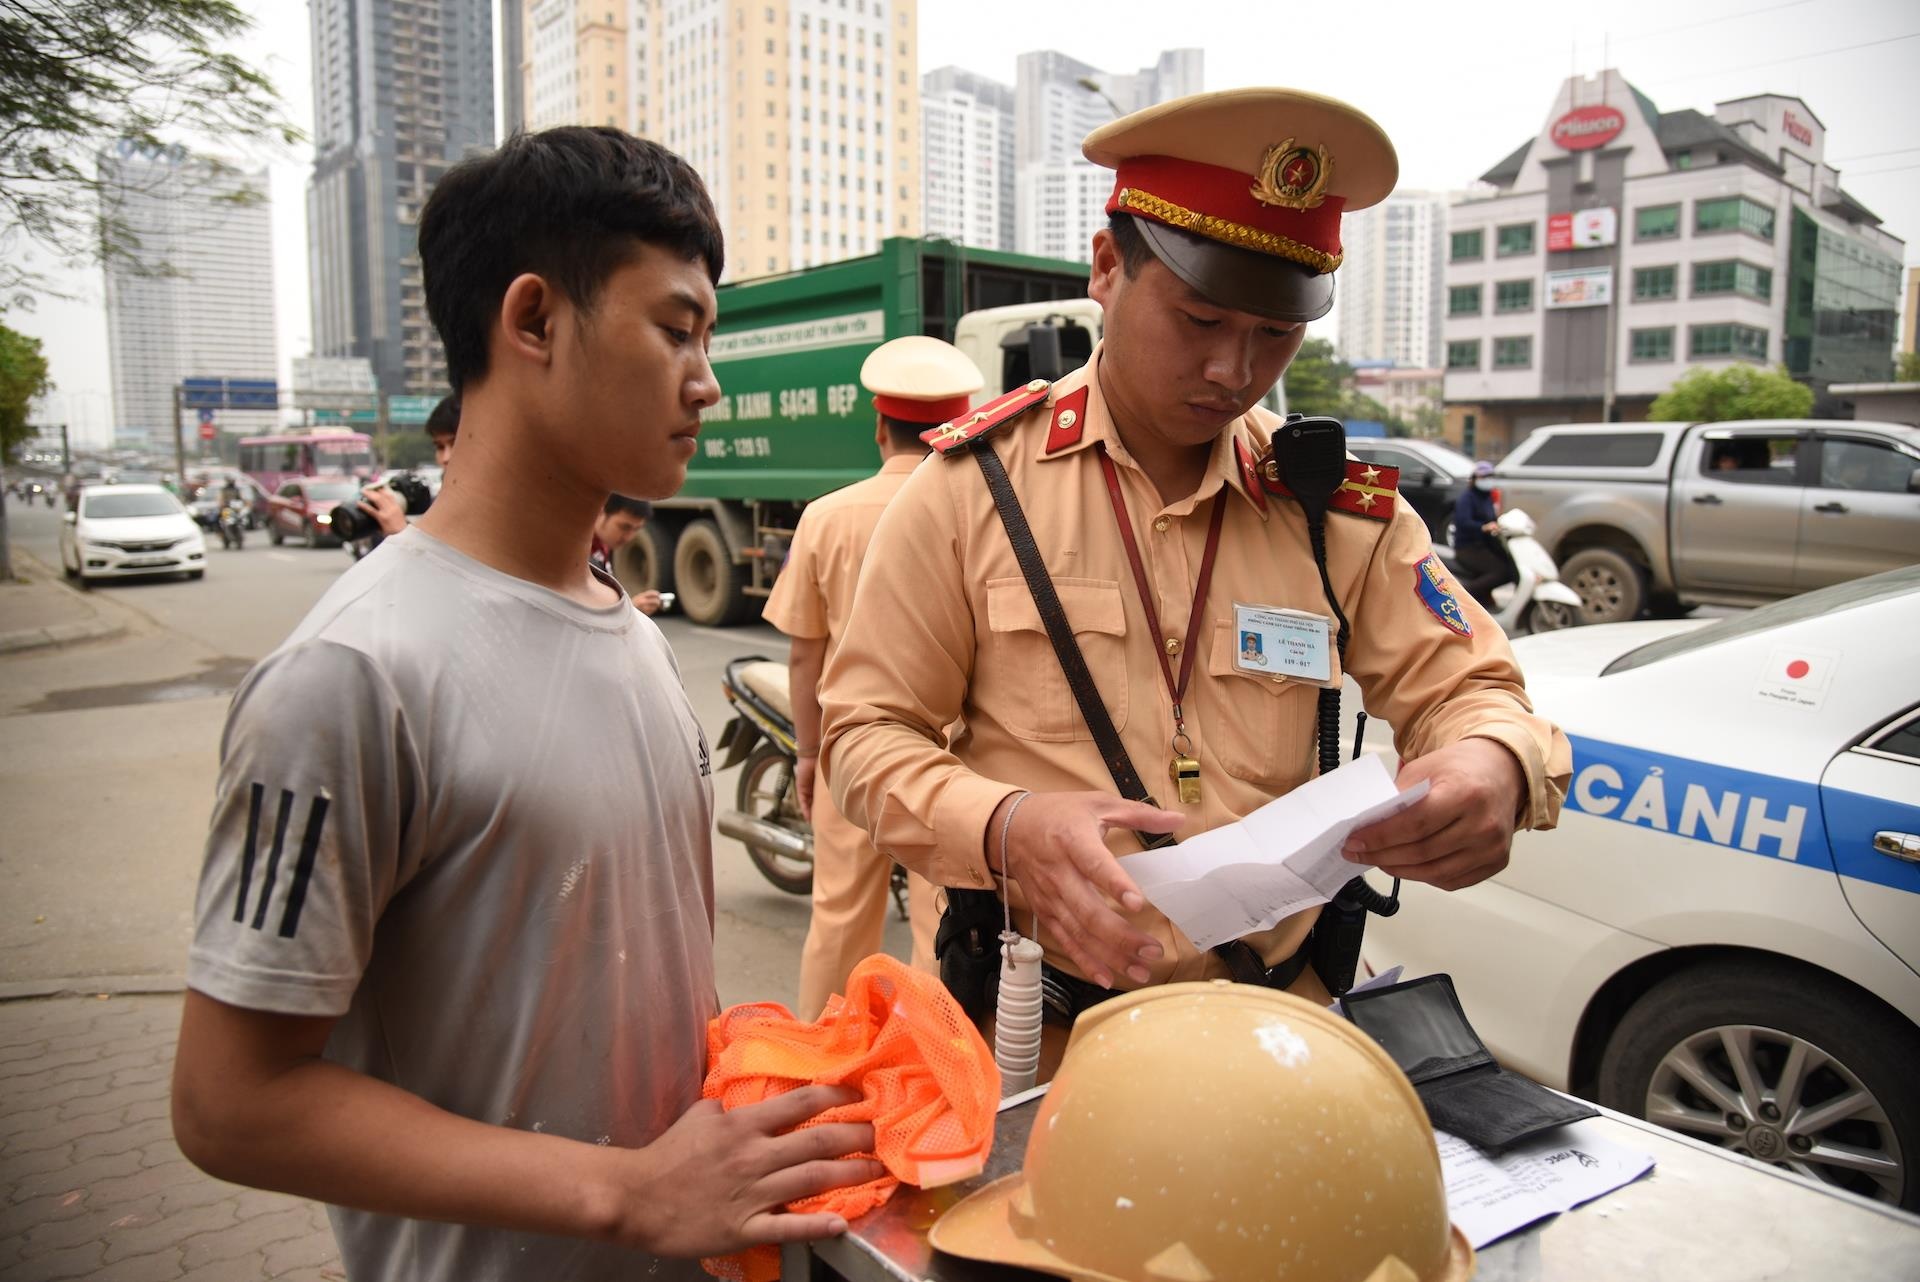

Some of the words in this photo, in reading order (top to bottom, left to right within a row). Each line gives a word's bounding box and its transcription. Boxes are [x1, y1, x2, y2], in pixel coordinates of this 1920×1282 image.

[1554, 116, 1619, 139] Miwon
[736, 391, 772, 421] XANH
[779, 387, 818, 421] SẠCH
[827, 384, 858, 418] ĐẸP
[1574, 763, 1808, 862] CẢNH
